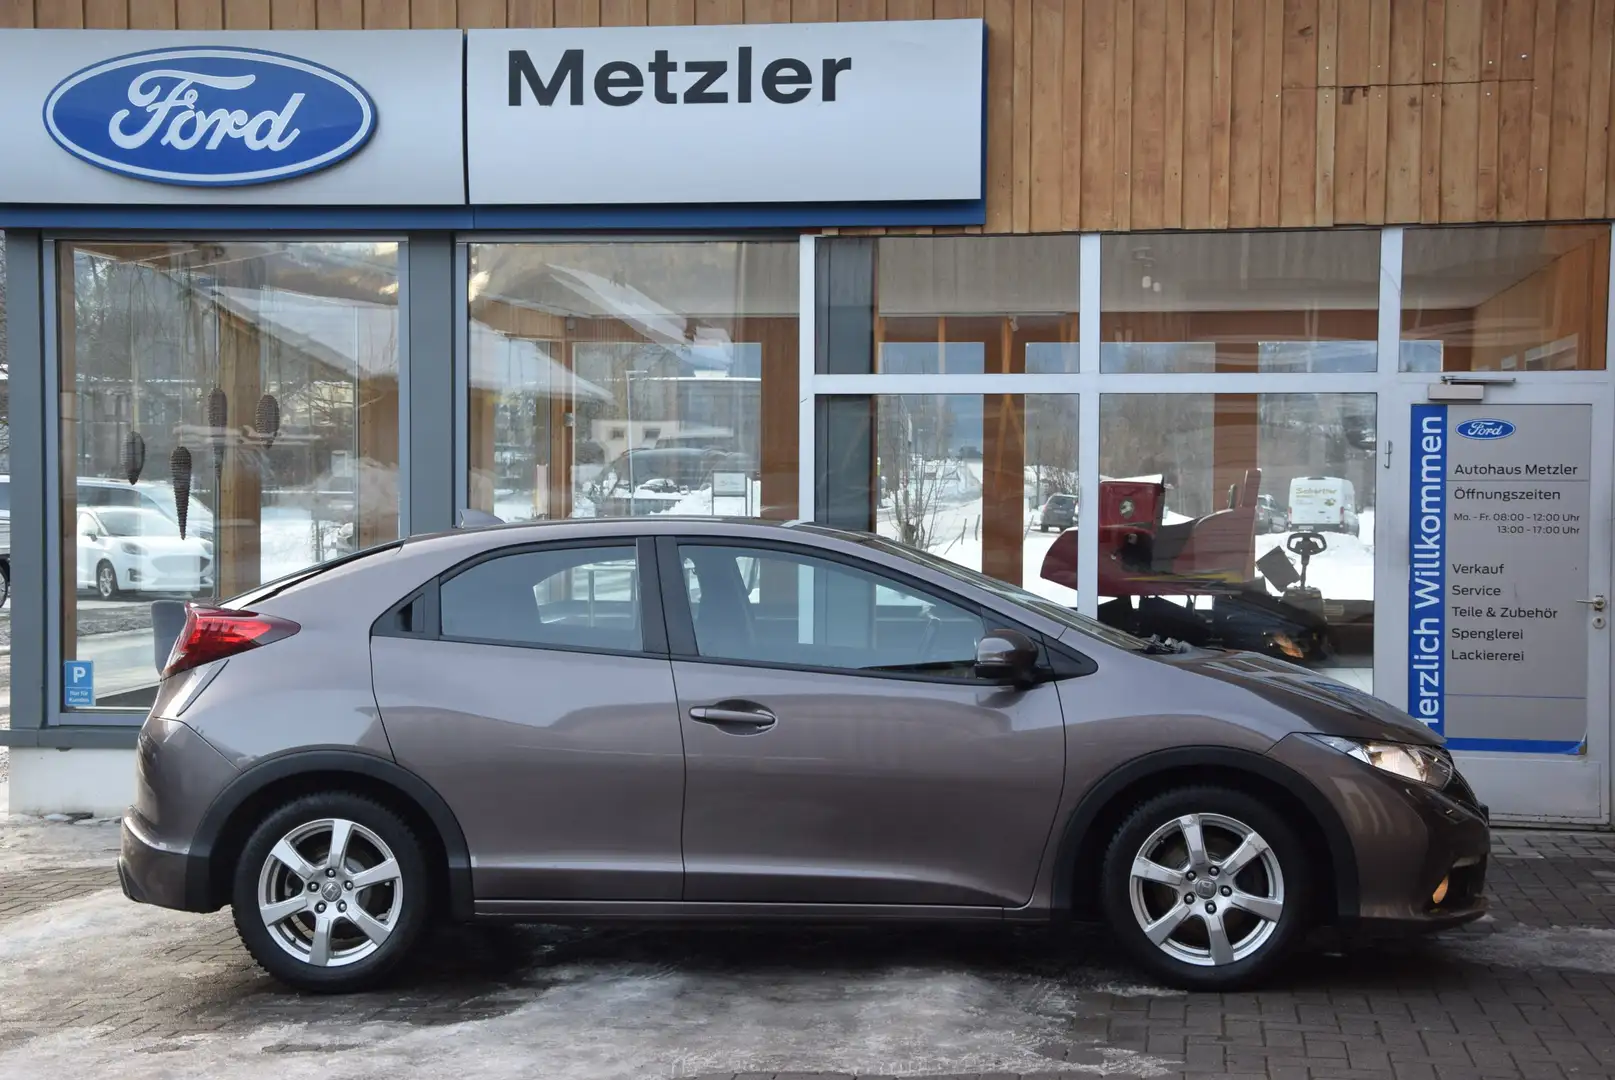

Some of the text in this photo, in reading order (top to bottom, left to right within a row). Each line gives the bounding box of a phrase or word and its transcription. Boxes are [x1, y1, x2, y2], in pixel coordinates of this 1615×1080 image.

[508, 46, 852, 107] Metzler
[109, 69, 306, 152] Ford
[1468, 420, 1503, 437] Ford
[1454, 464, 1578, 476] Autohaus Metzler
[1454, 487, 1561, 502] Öffnungszeiten
[1414, 416, 1442, 609] Willkommen
[1479, 513, 1491, 521] Fr.
[1493, 513, 1524, 522] 08:00
[1533, 513, 1560, 522] 12:00
[1562, 513, 1580, 522] Uhr
[1497, 525, 1524, 534] 13:00
[1533, 525, 1560, 535] 17:00
[1562, 525, 1580, 535] Uhr
[1451, 563, 1505, 575] Verkauf
[1451, 585, 1502, 597] Service
[1451, 606, 1559, 619] Teile & Zubehör
[1451, 628, 1524, 641] Spenglerei
[1451, 649, 1525, 662] Lackiererei
